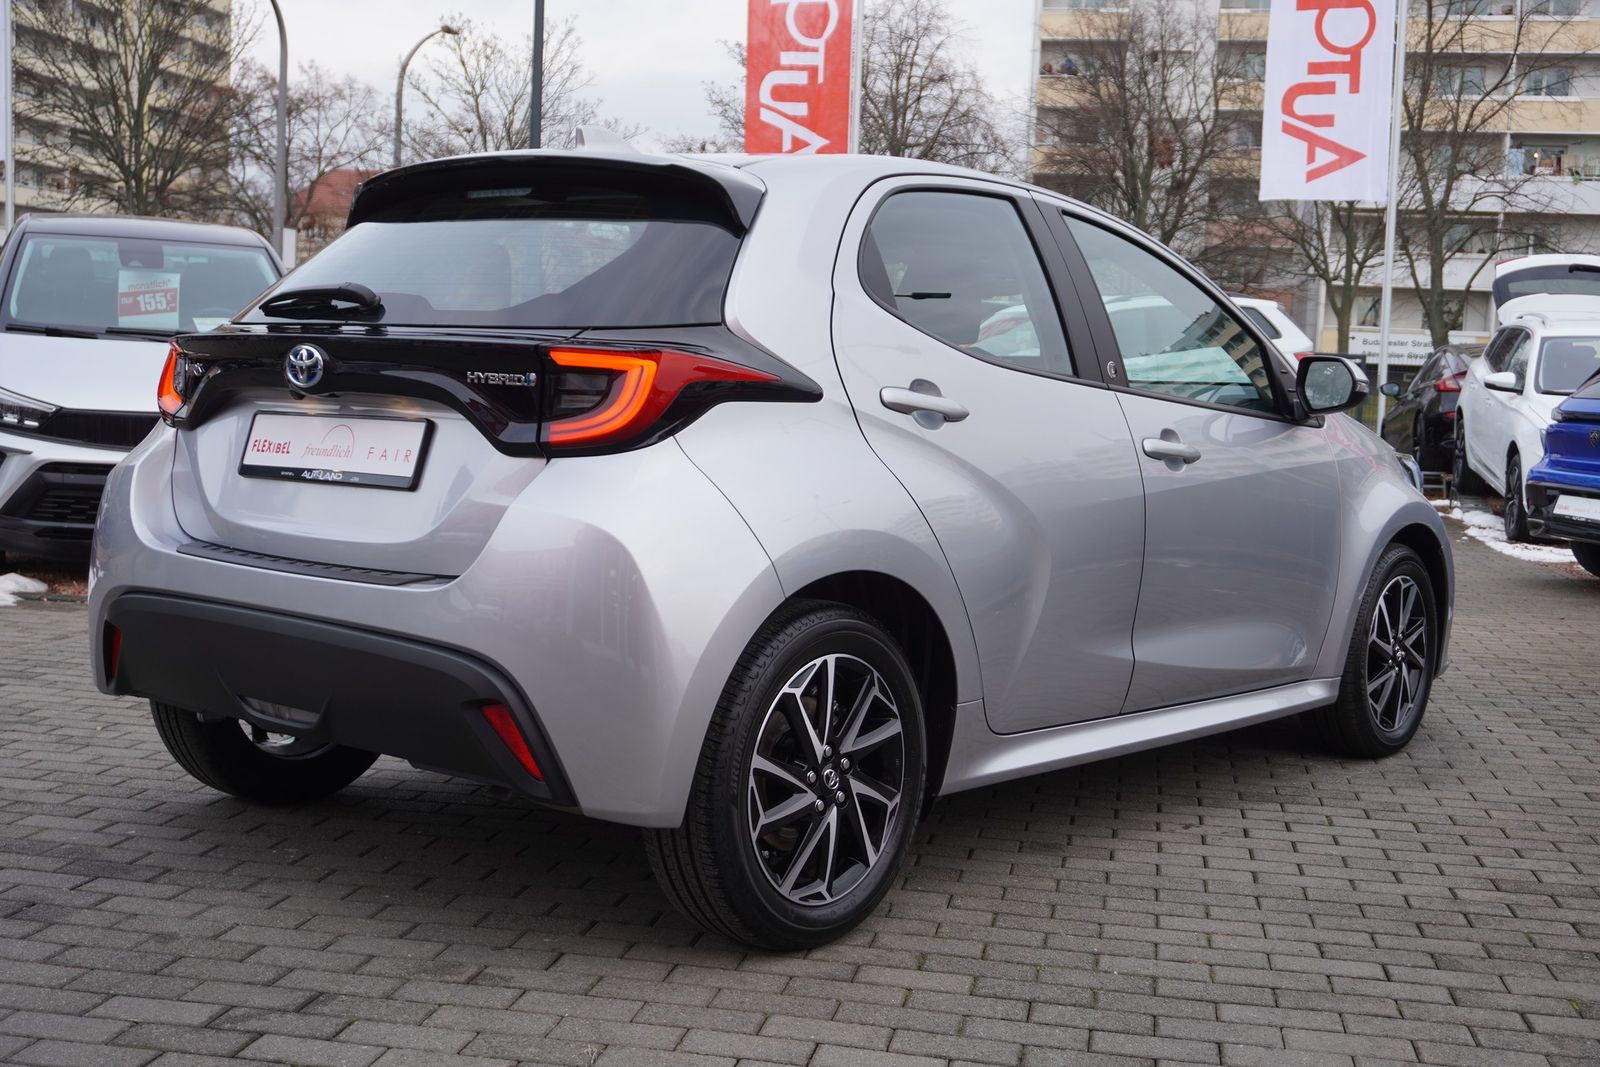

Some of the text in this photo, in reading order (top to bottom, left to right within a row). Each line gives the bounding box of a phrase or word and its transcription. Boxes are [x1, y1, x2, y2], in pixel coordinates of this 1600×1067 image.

[466, 371, 525, 386] HYBRID
[252, 439, 292, 455] FLEXIBEL
[301, 444, 351, 459] freundlich
